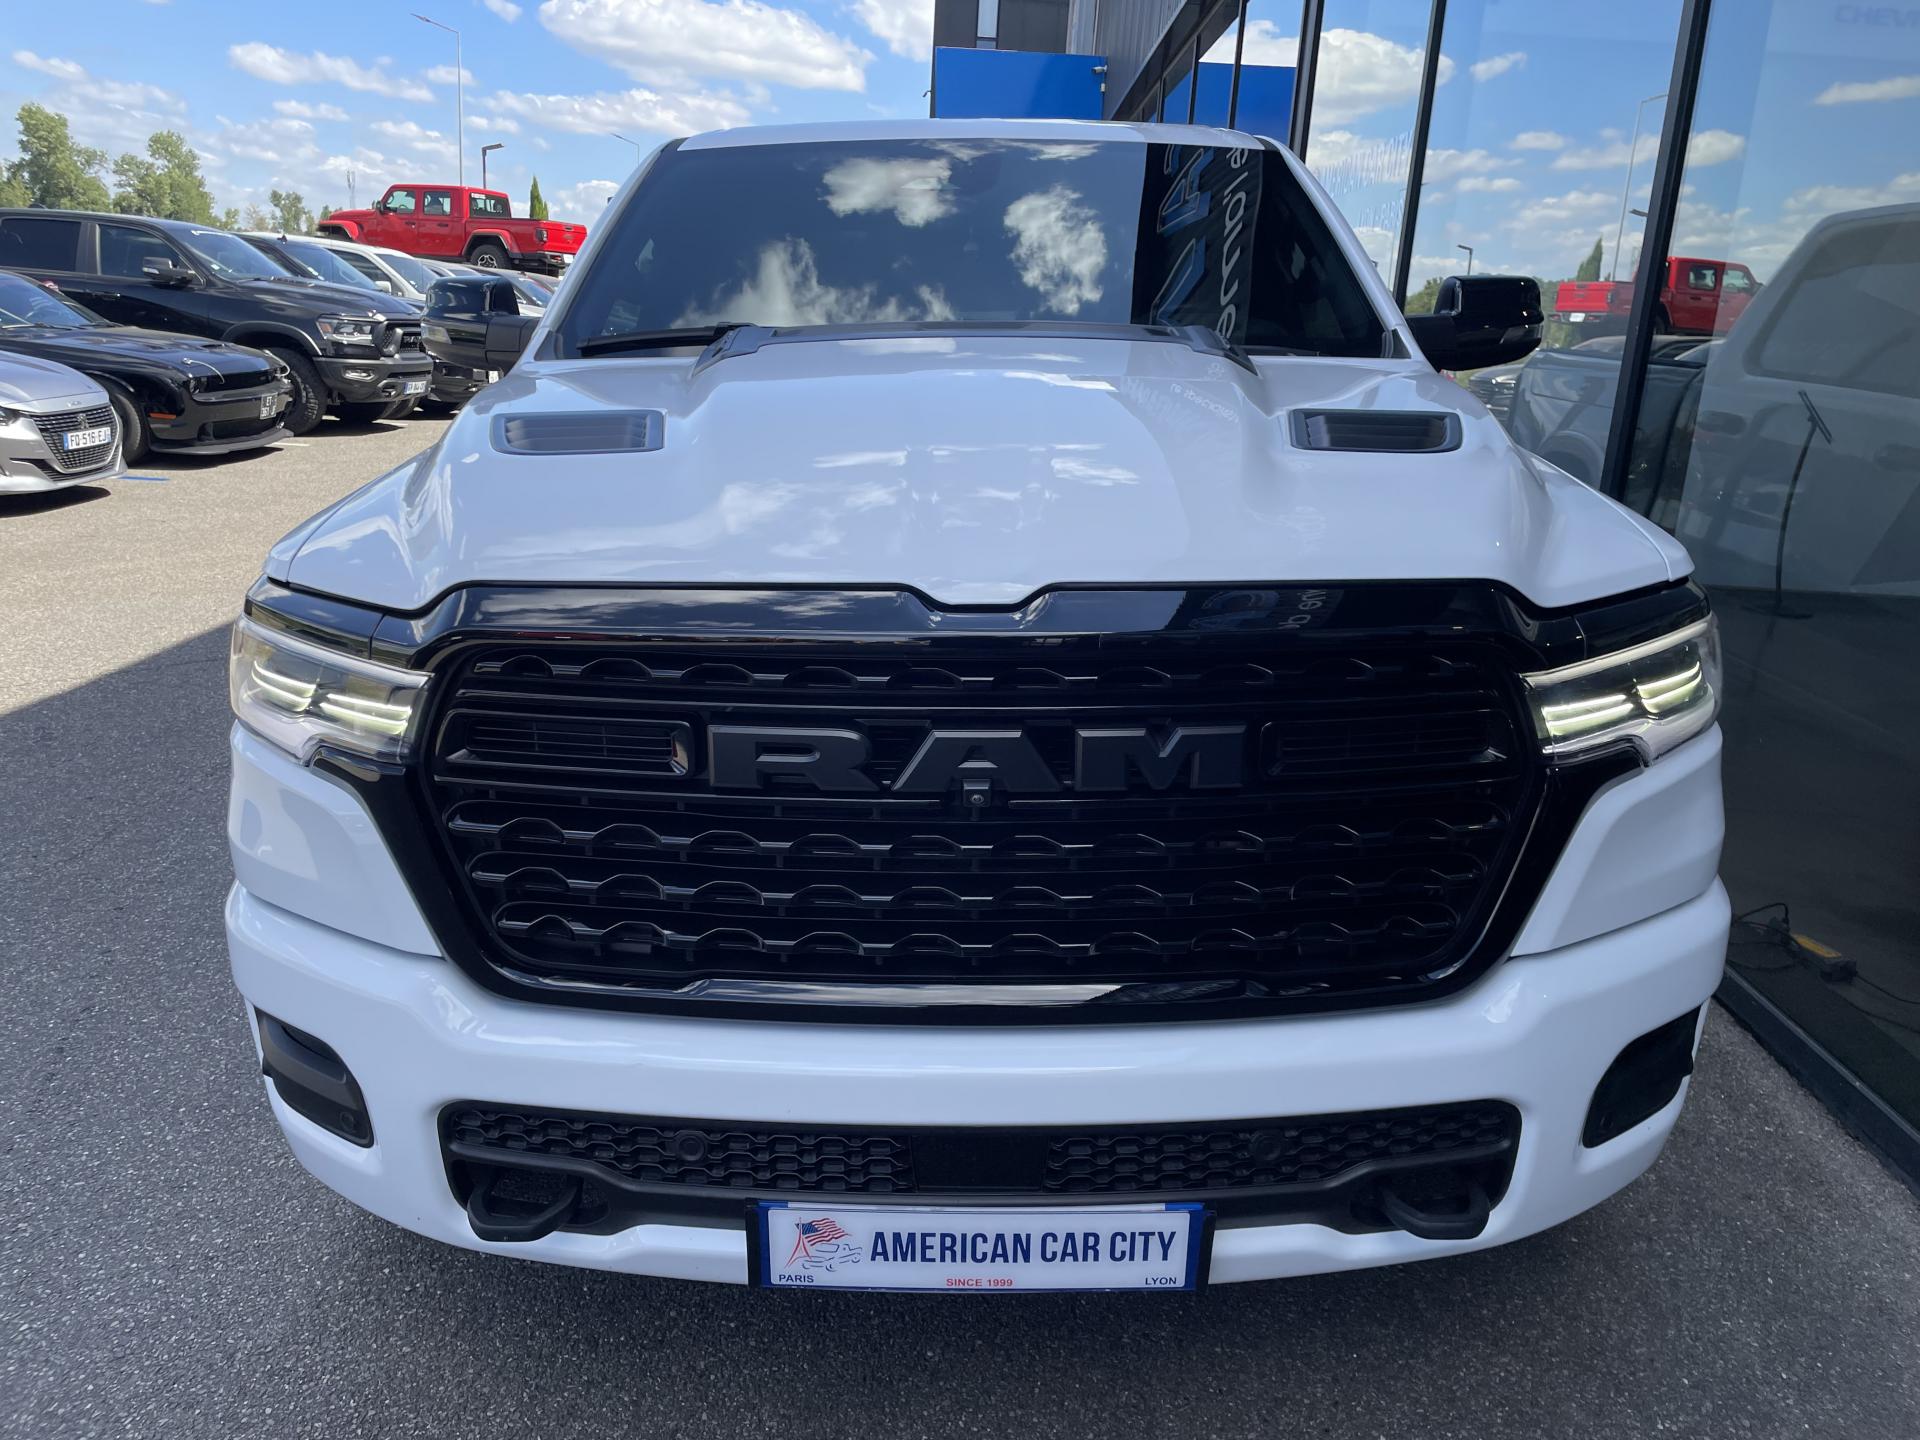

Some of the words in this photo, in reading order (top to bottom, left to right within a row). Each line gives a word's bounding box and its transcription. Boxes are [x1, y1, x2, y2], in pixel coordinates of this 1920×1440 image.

[707, 725, 1247, 792] RAM
[869, 1231, 1032, 1263] AMERICAN
[1040, 1231, 1100, 1262] CAR
[1109, 1230, 1177, 1262] CITY
[778, 1273, 815, 1284] PARIS
[946, 1277, 982, 1288] SINCE
[987, 1277, 1013, 1288] 1999
[1145, 1276, 1177, 1286] LYON
